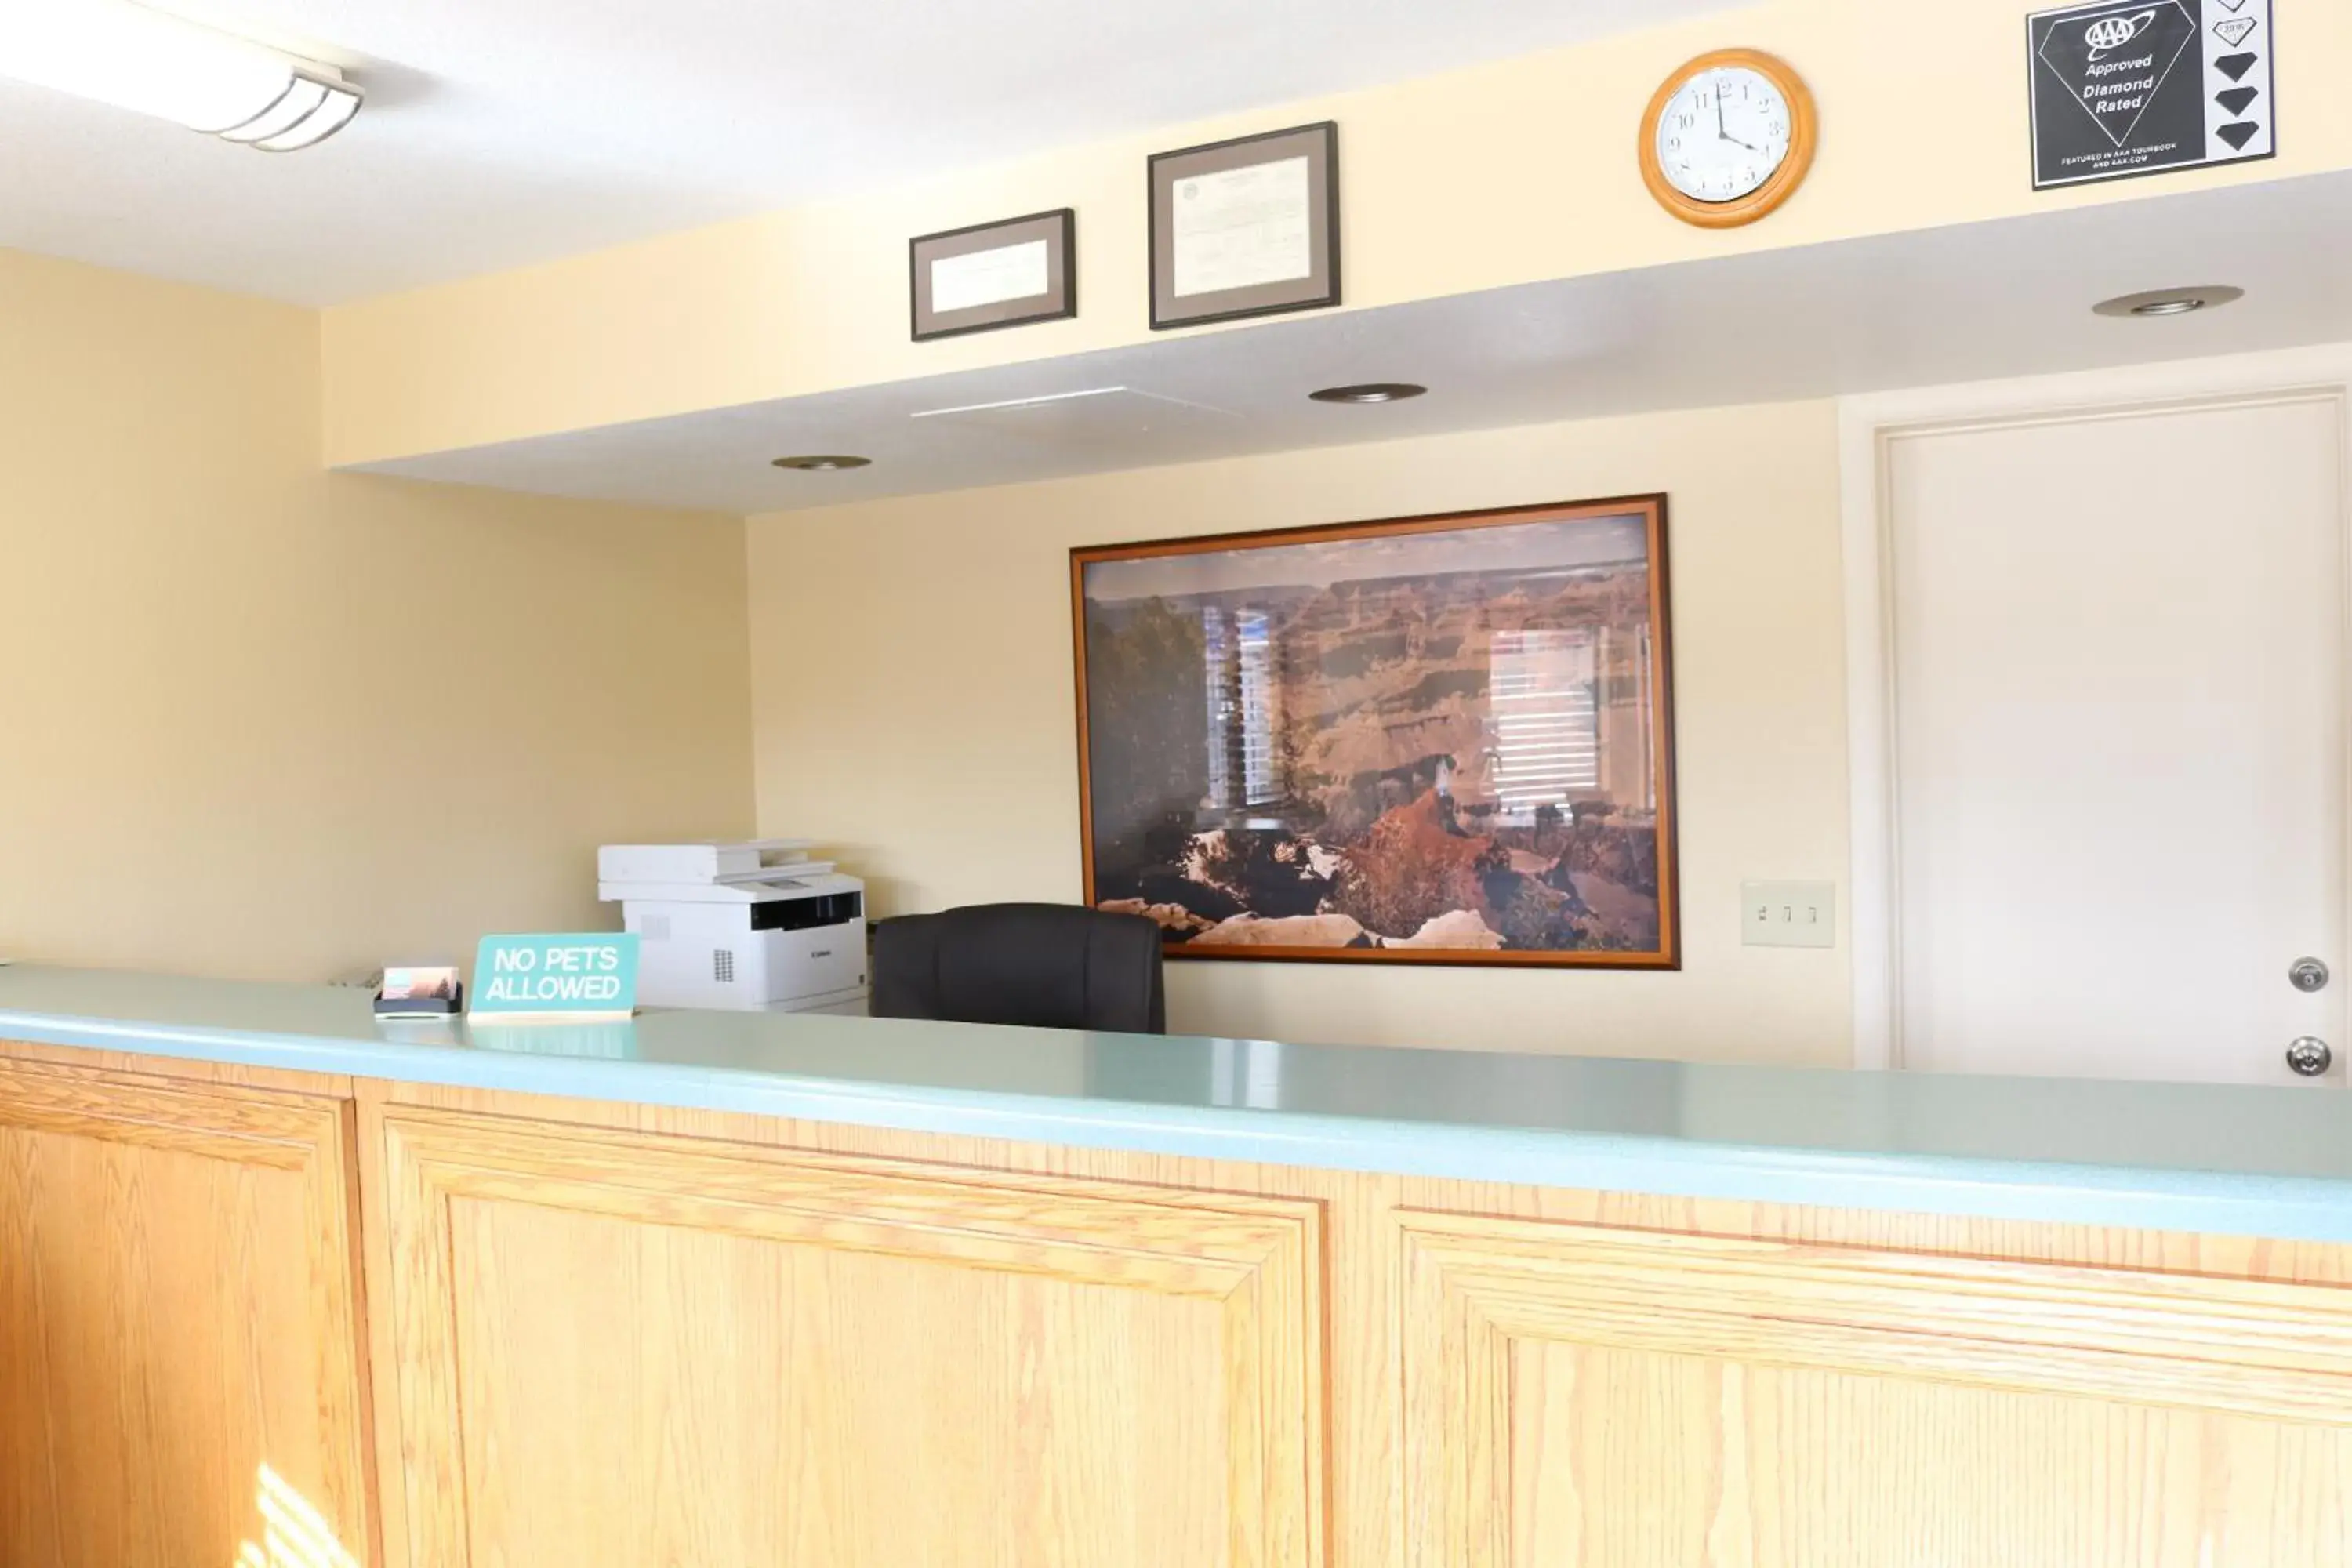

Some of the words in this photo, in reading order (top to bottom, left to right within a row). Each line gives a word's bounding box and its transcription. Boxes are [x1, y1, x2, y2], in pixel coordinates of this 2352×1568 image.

[2089, 19, 2131, 47] AAA
[2085, 54, 2153, 78] Approved
[2083, 75, 2154, 99] Diamond
[1694, 93, 1708, 110] 11
[2096, 95, 2142, 114] Rated
[1679, 113, 1694, 130] 10
[494, 948, 535, 971] NO
[543, 947, 619, 971] PETS
[485, 976, 621, 1000] ALLOWED
